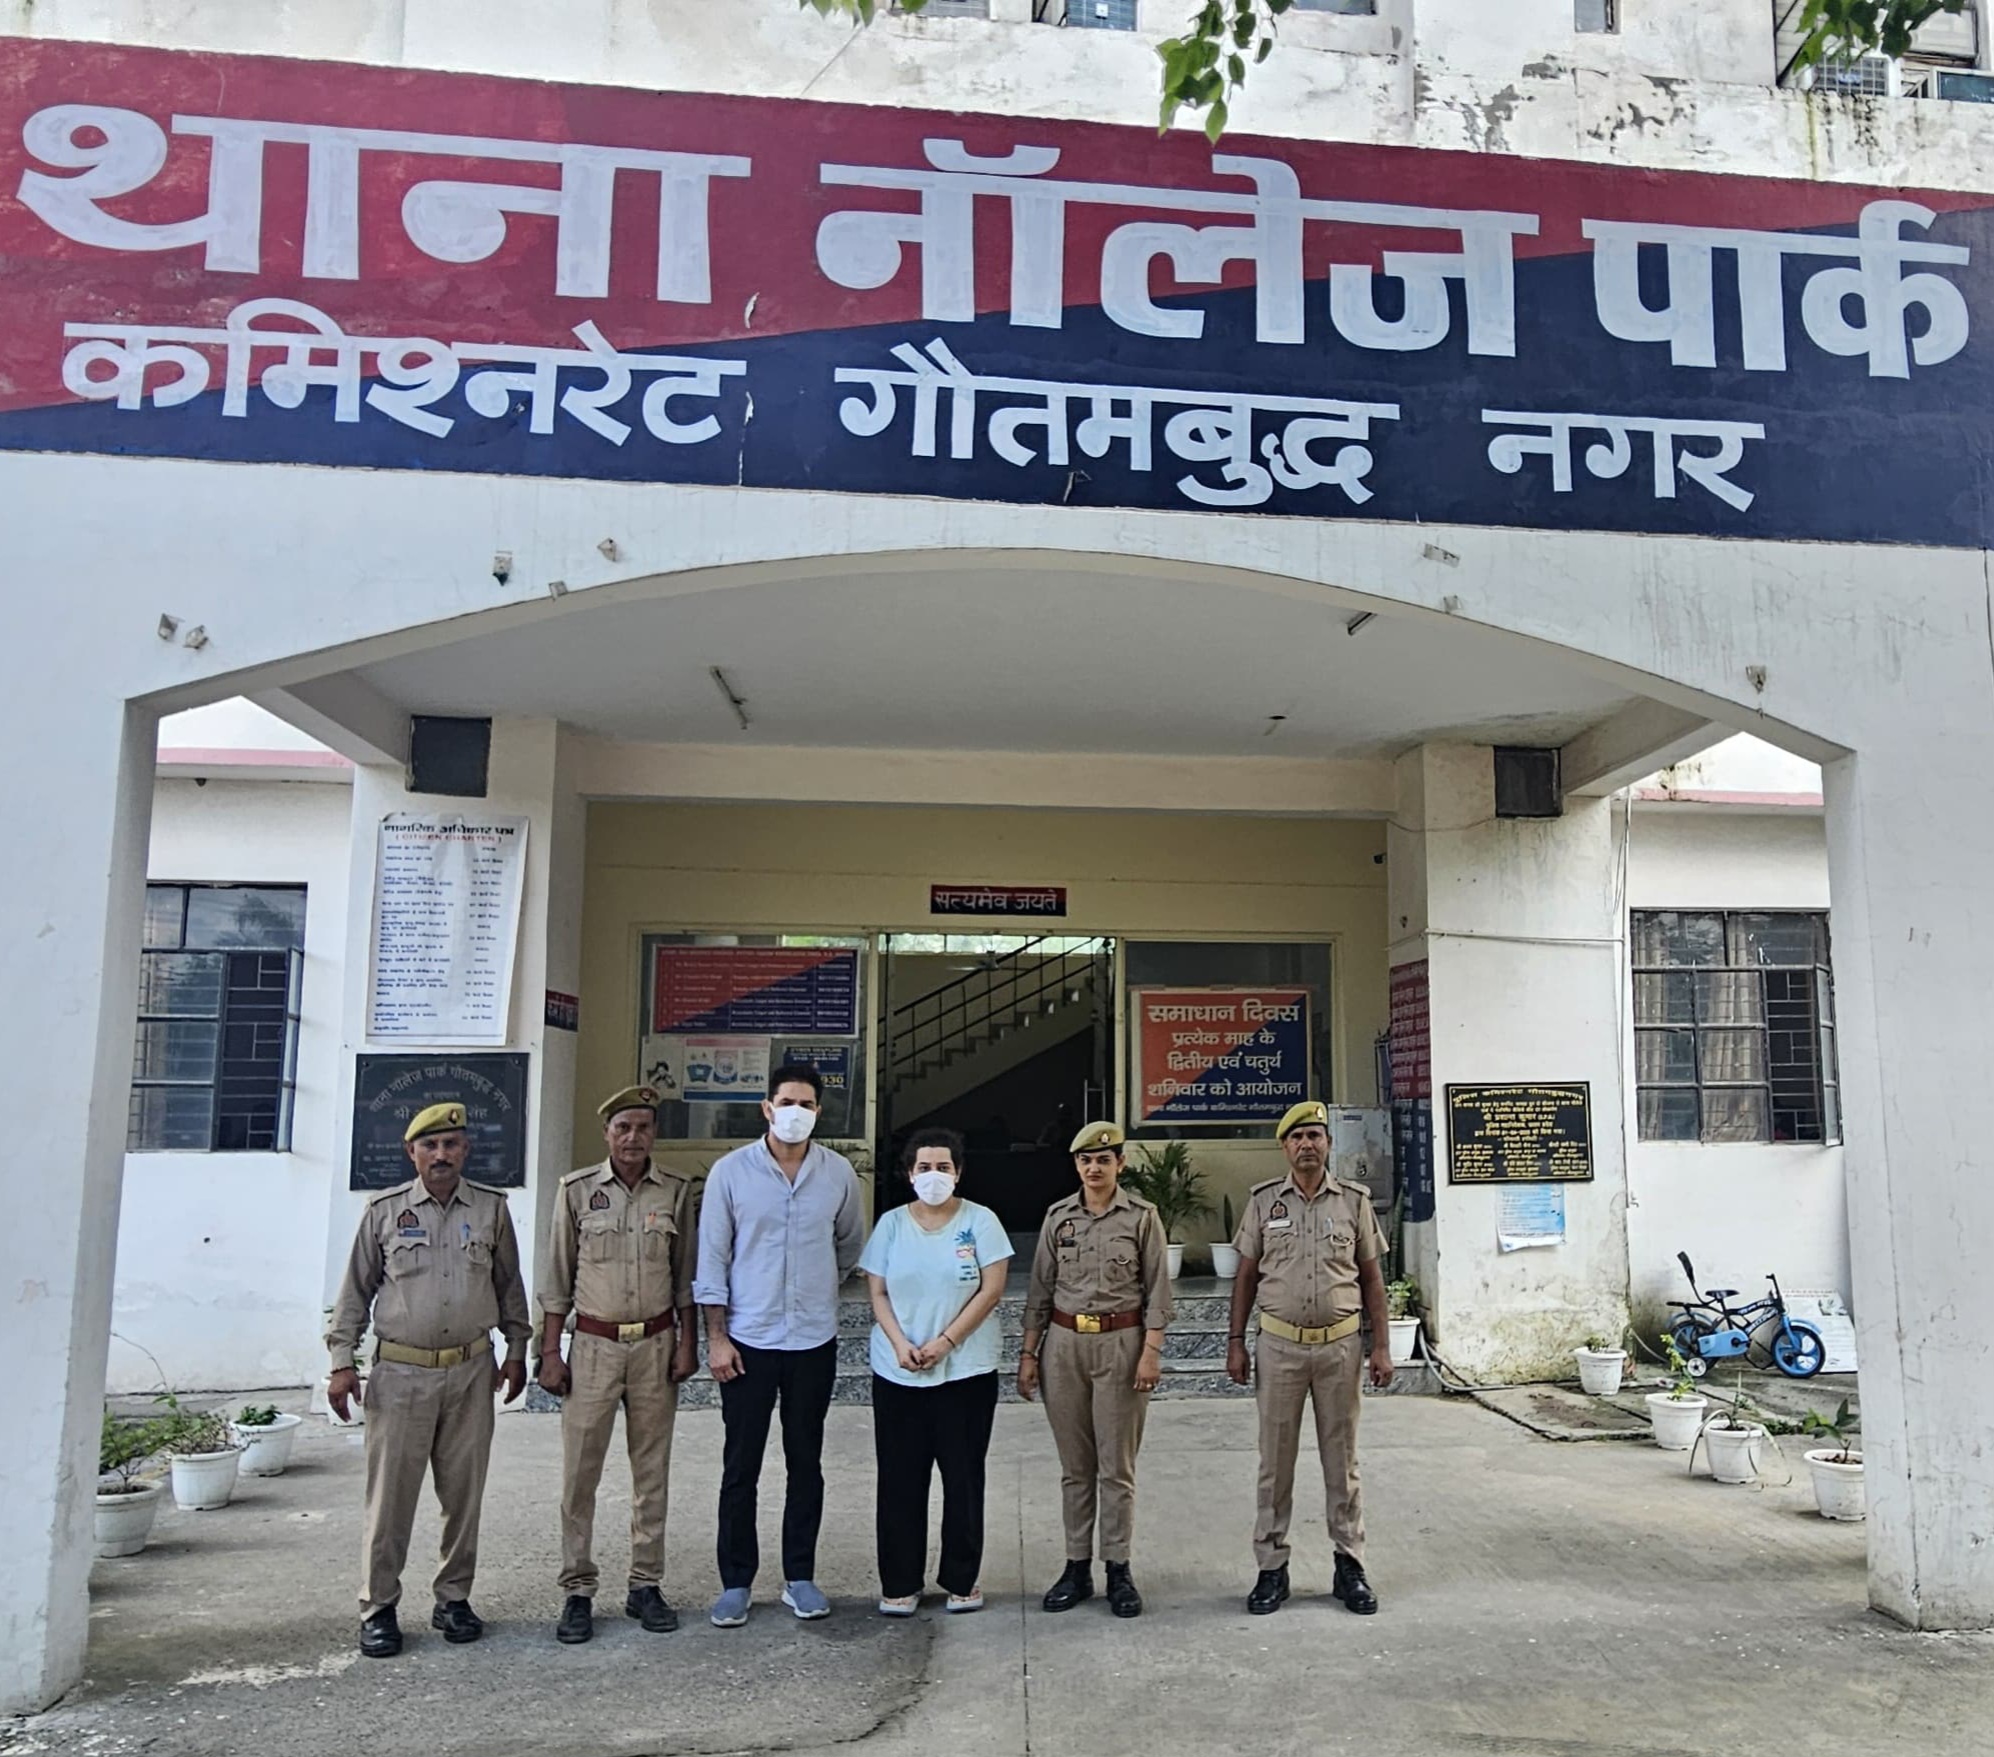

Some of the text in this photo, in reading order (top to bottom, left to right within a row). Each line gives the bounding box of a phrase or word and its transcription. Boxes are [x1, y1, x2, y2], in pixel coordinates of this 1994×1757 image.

[16, 104, 1970, 379] थाना नॉलेज पार्क
[62, 297, 1766, 512] कमिश्नरेट गौतमबुद्ध नगर
[935, 887, 1058, 911] सत्यमेव जयते
[1148, 998, 1300, 1022] समाधान दिवस
[1172, 1028, 1277, 1047] प्रत्येक माह के
[1167, 1050, 1214, 1071] द्वितीय
[1217, 1051, 1242, 1069] एवं
[1148, 1078, 1302, 1096] शनिवार को आयोजन
